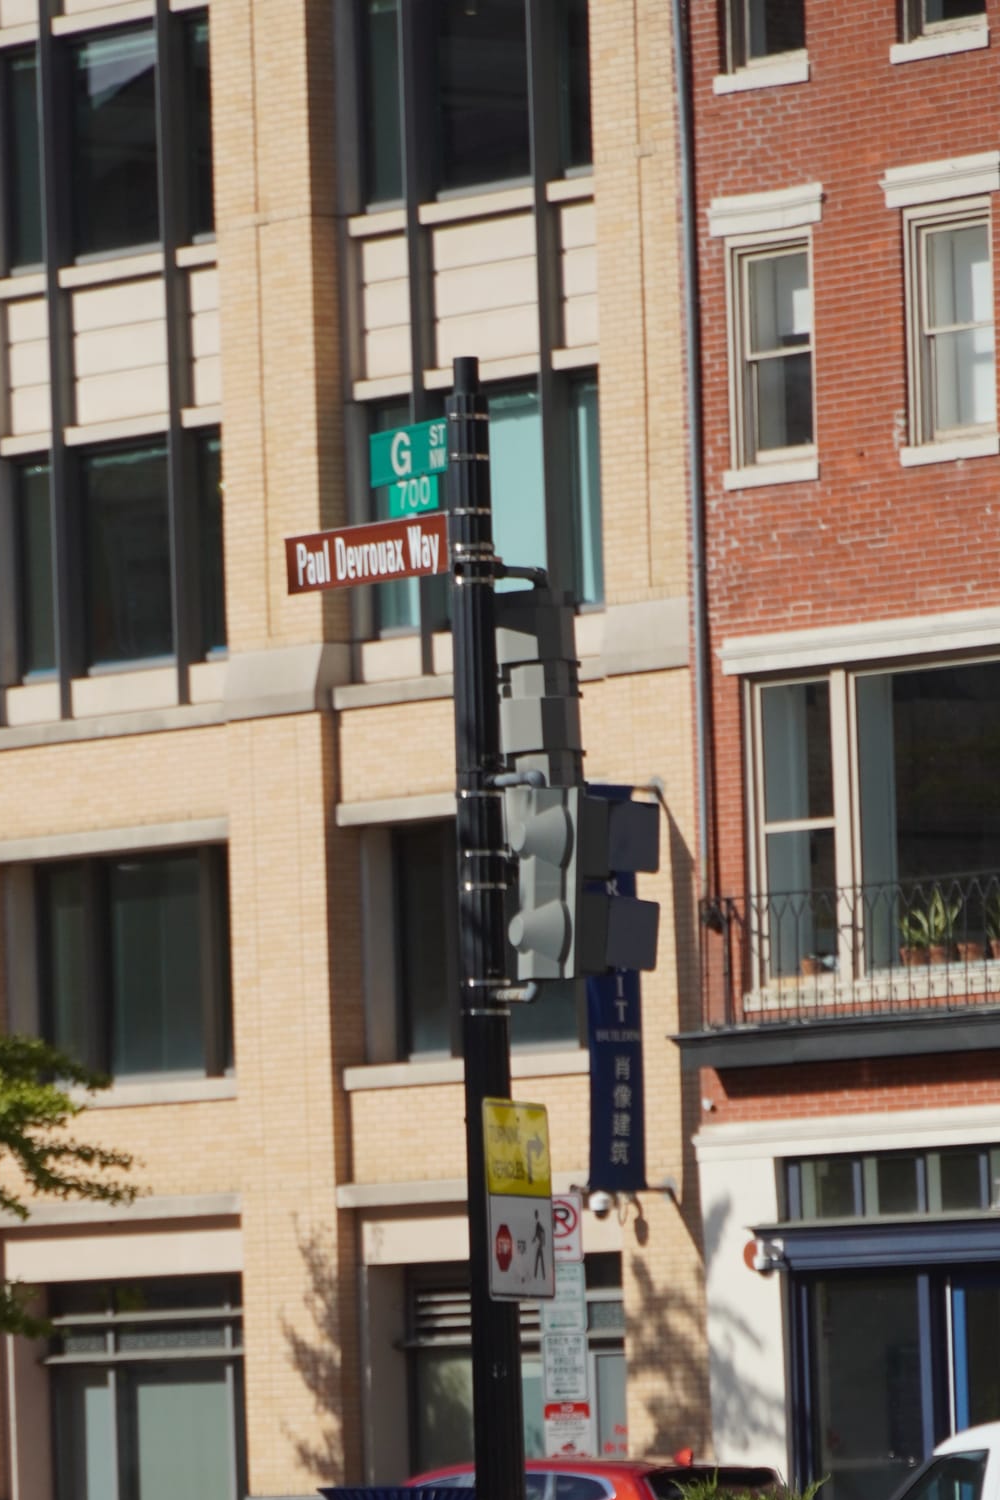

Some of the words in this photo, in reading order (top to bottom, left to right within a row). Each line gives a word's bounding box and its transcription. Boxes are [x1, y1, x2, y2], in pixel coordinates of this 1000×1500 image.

[390, 431, 412, 476] G
[428, 424, 446, 447] ST
[429, 447, 446, 468] NW
[396, 475, 431, 510] 700
[295, 539, 331, 587] Paul
[334, 536, 405, 581] Devrouax
[406, 525, 440, 575] Way
